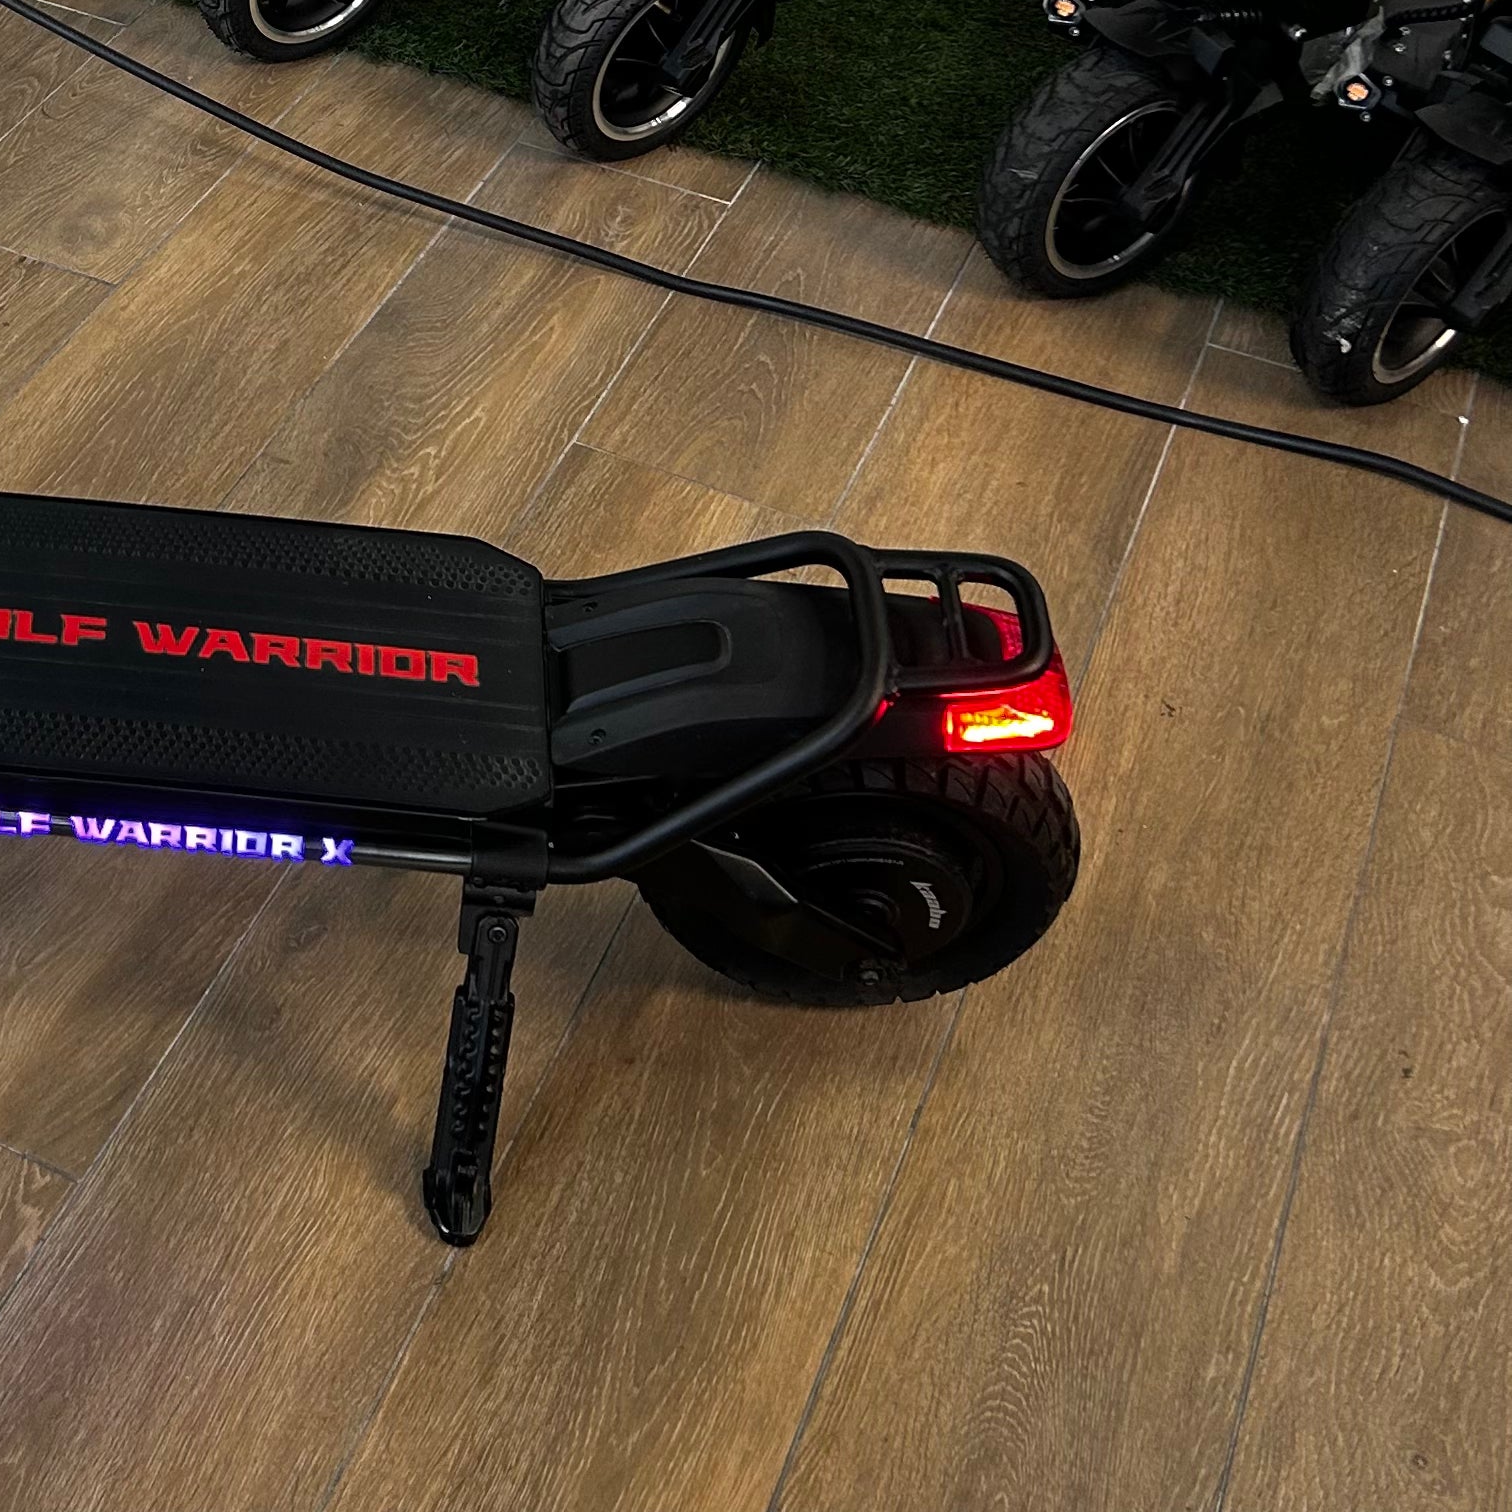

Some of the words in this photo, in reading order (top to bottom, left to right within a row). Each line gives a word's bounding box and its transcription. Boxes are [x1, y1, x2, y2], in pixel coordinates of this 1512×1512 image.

[132, 620, 480, 686] WARRIOR
[70, 815, 306, 863] WARRIOR
[320, 836, 355, 866] X
[909, 880, 949, 929] kaabo
